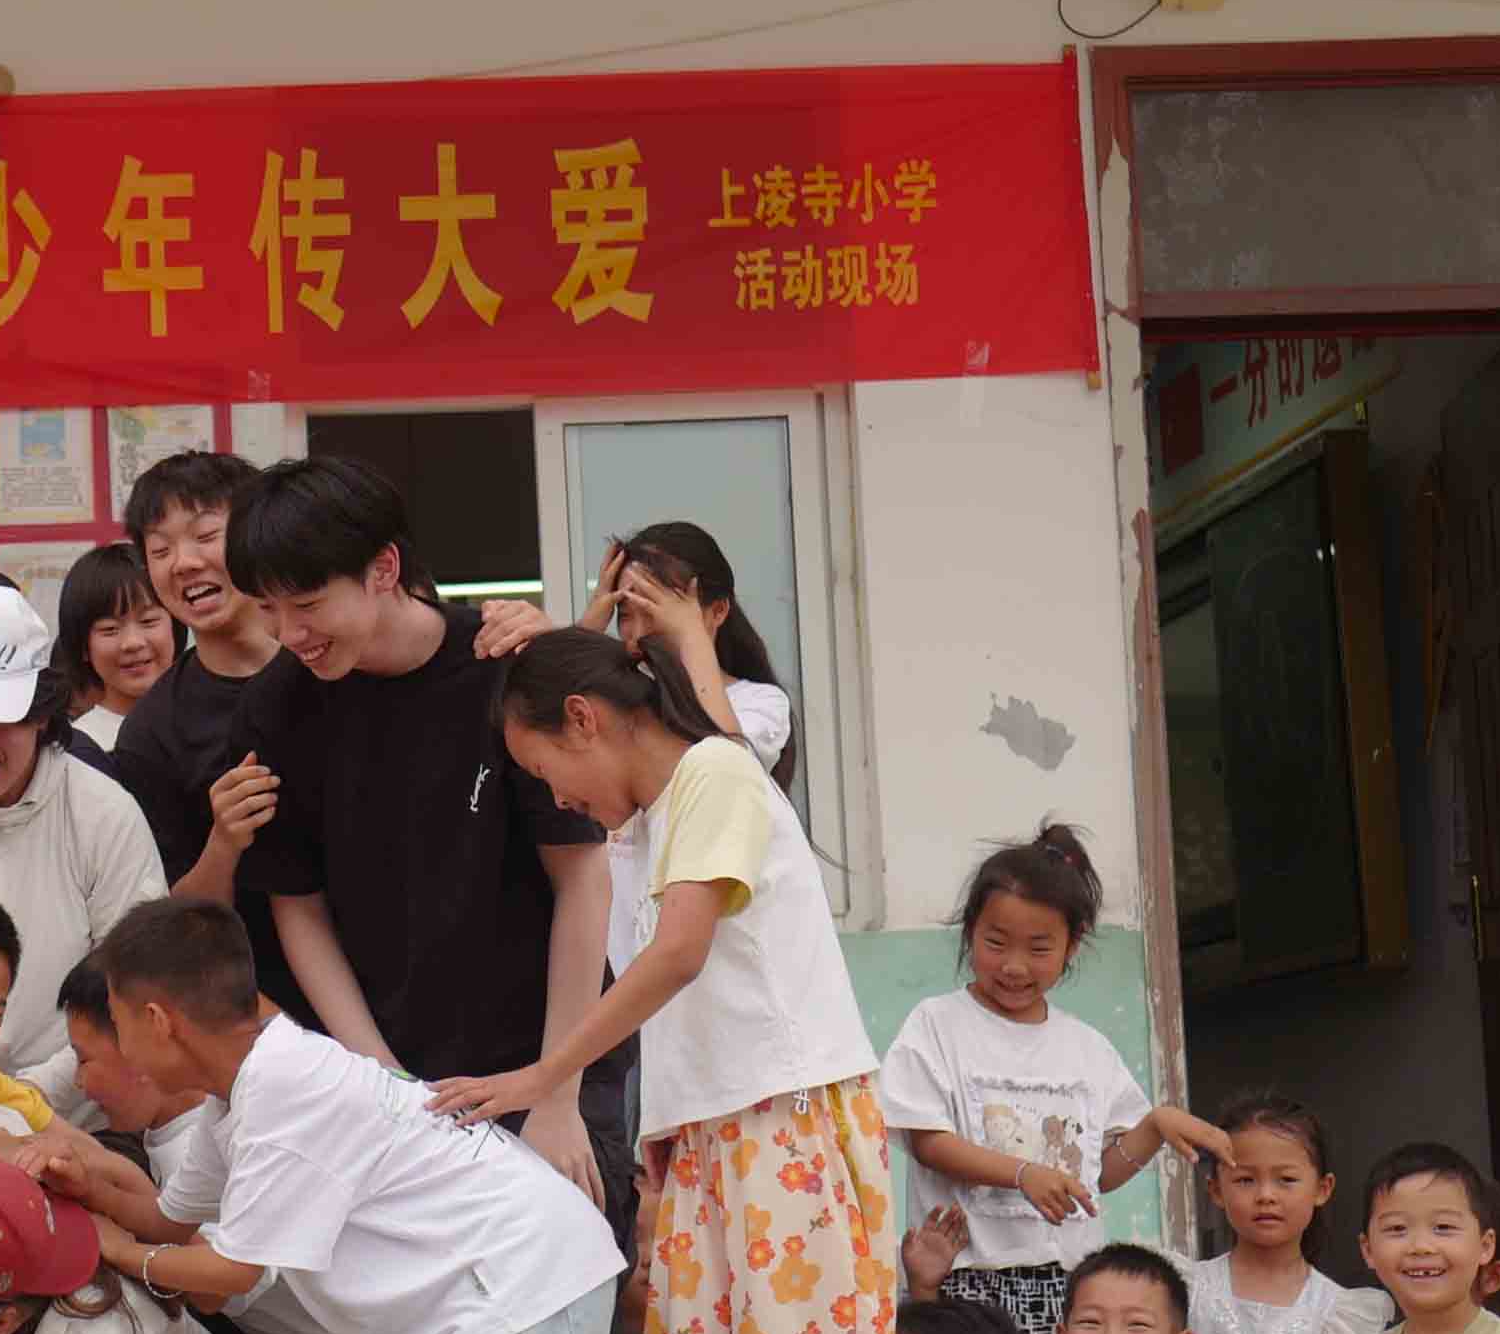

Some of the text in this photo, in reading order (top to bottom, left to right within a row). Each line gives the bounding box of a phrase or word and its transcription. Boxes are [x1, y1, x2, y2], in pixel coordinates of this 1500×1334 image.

[708, 160, 937, 229] 上凌寺小学
[734, 243, 920, 310] 活动现场
